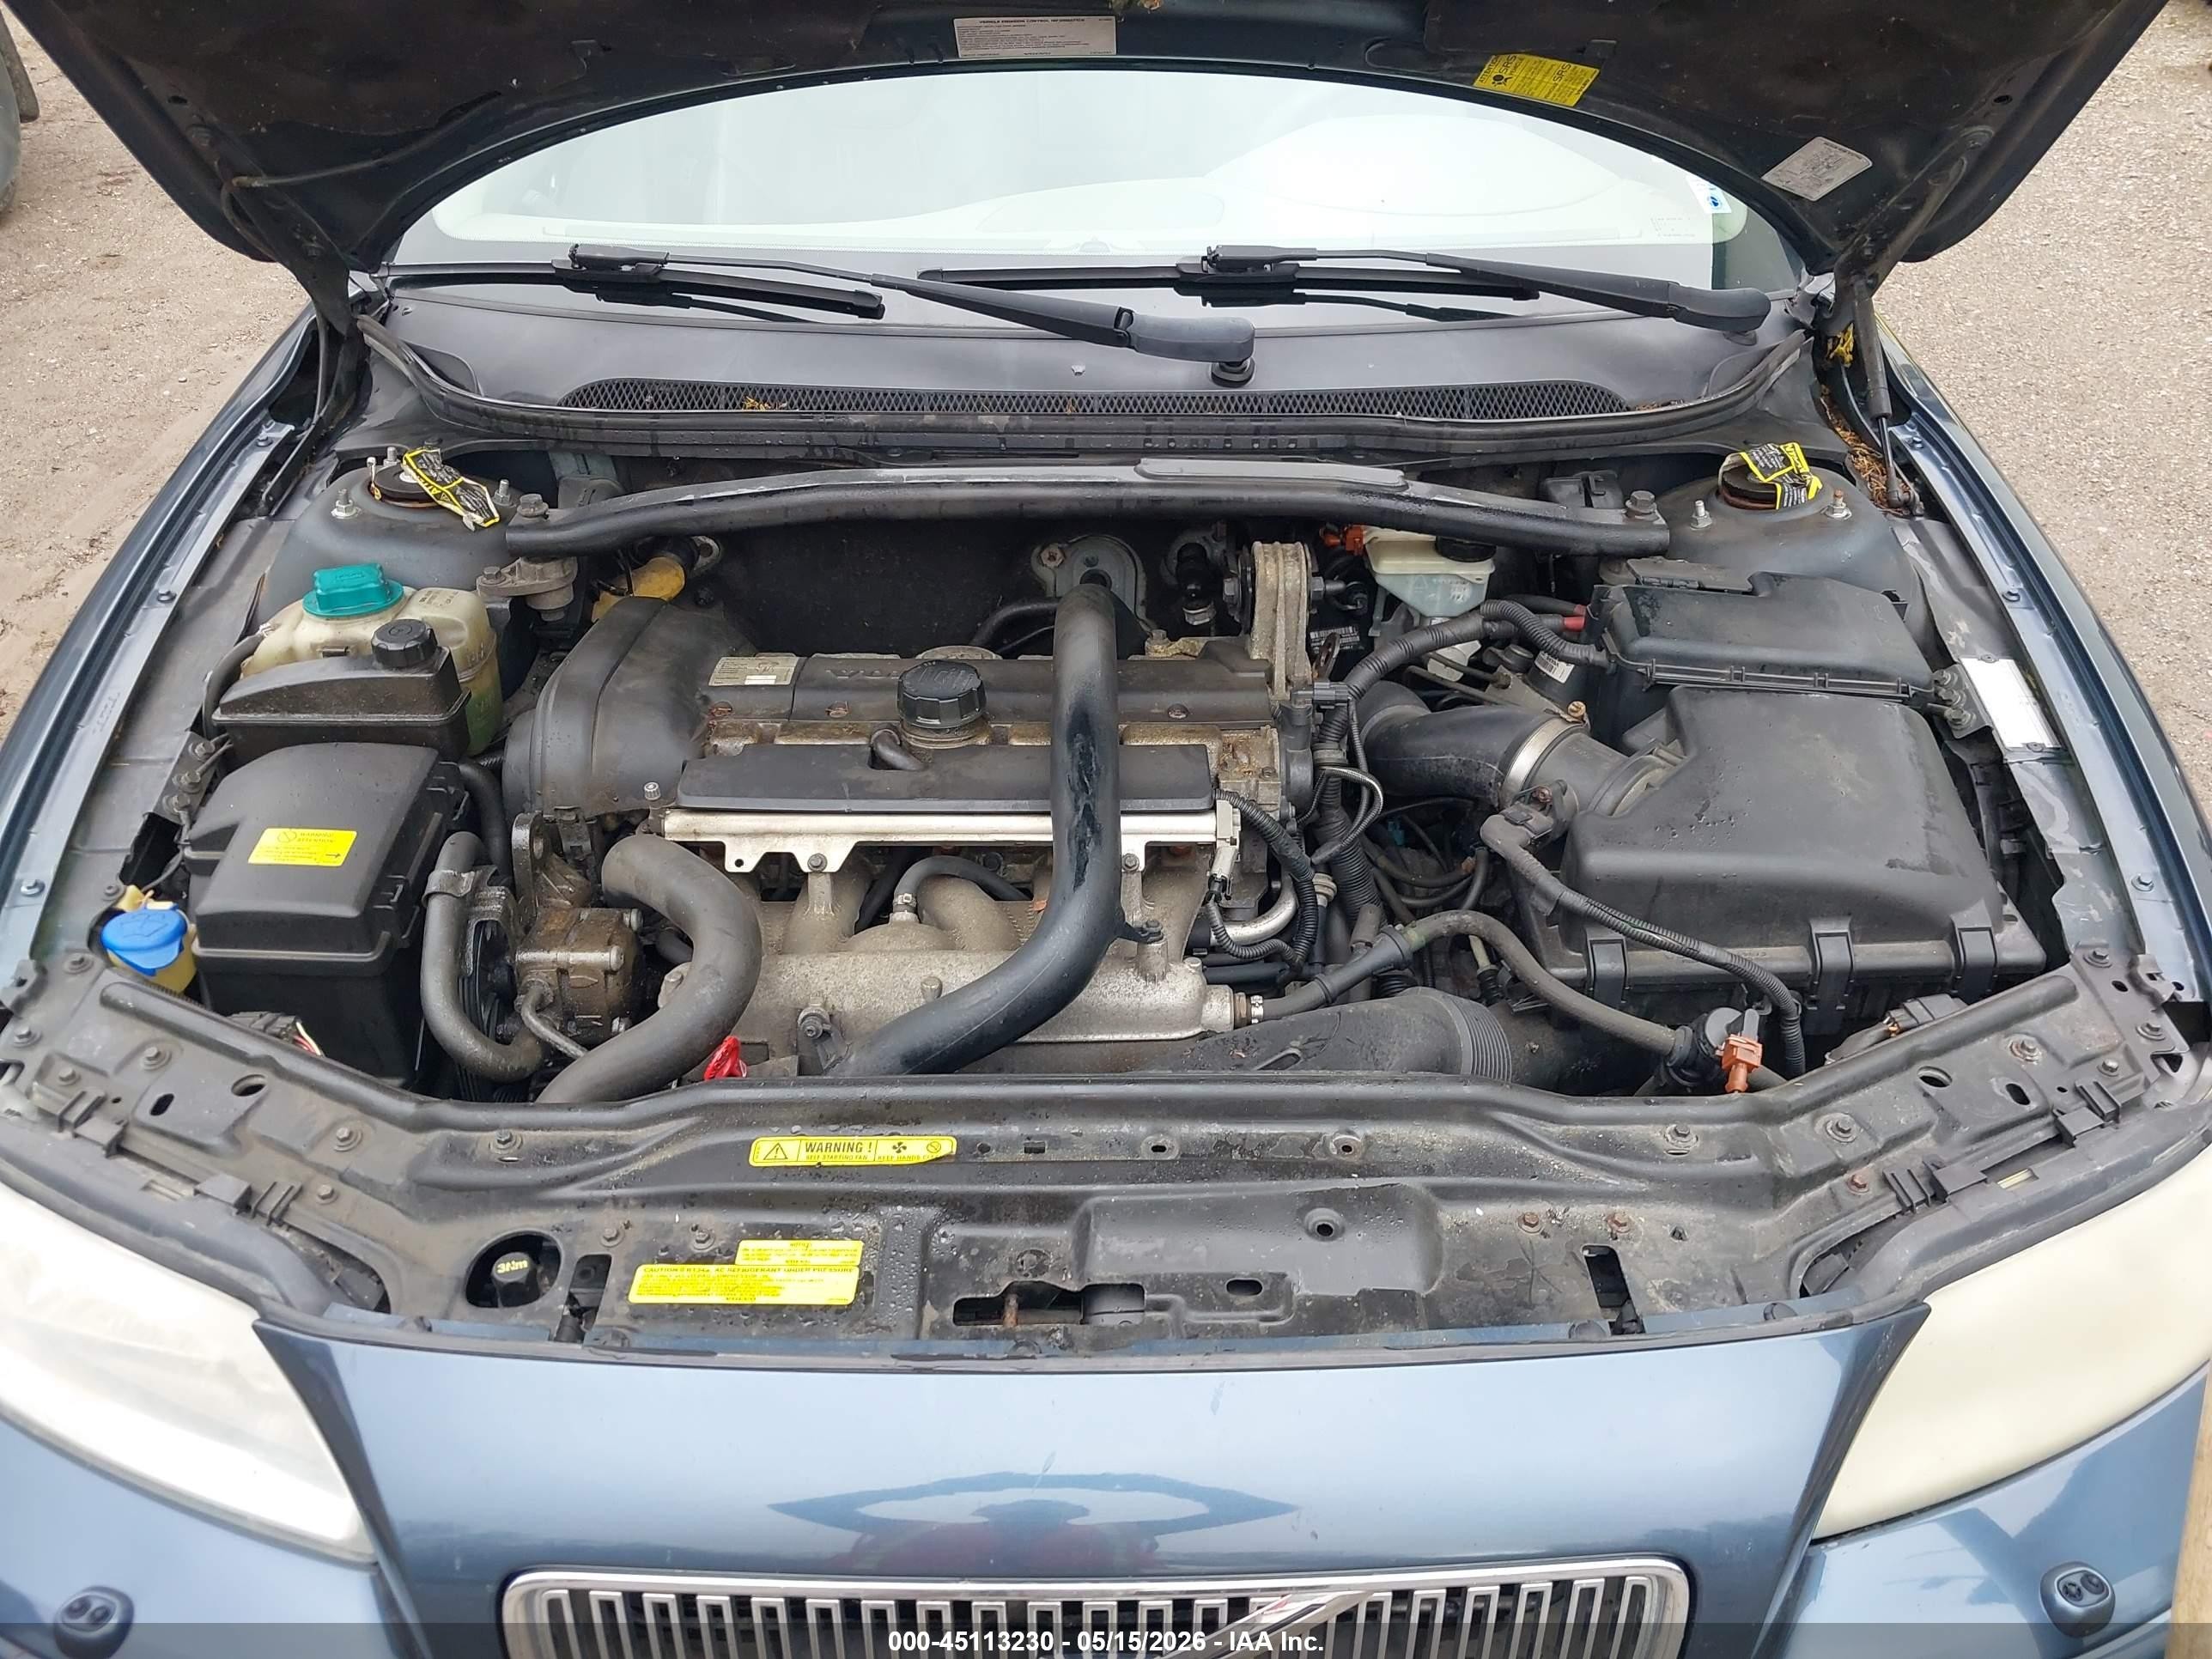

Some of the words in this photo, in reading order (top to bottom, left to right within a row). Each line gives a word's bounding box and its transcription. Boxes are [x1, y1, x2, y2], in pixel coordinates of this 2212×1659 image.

[1498, 55, 1517, 74] SRS
[1553, 63, 1572, 83] SRS
[805, 1141, 864, 1153] WARNING
[867, 1141, 873, 1153] !
[496, 1260, 529, 1274] 3Nm
